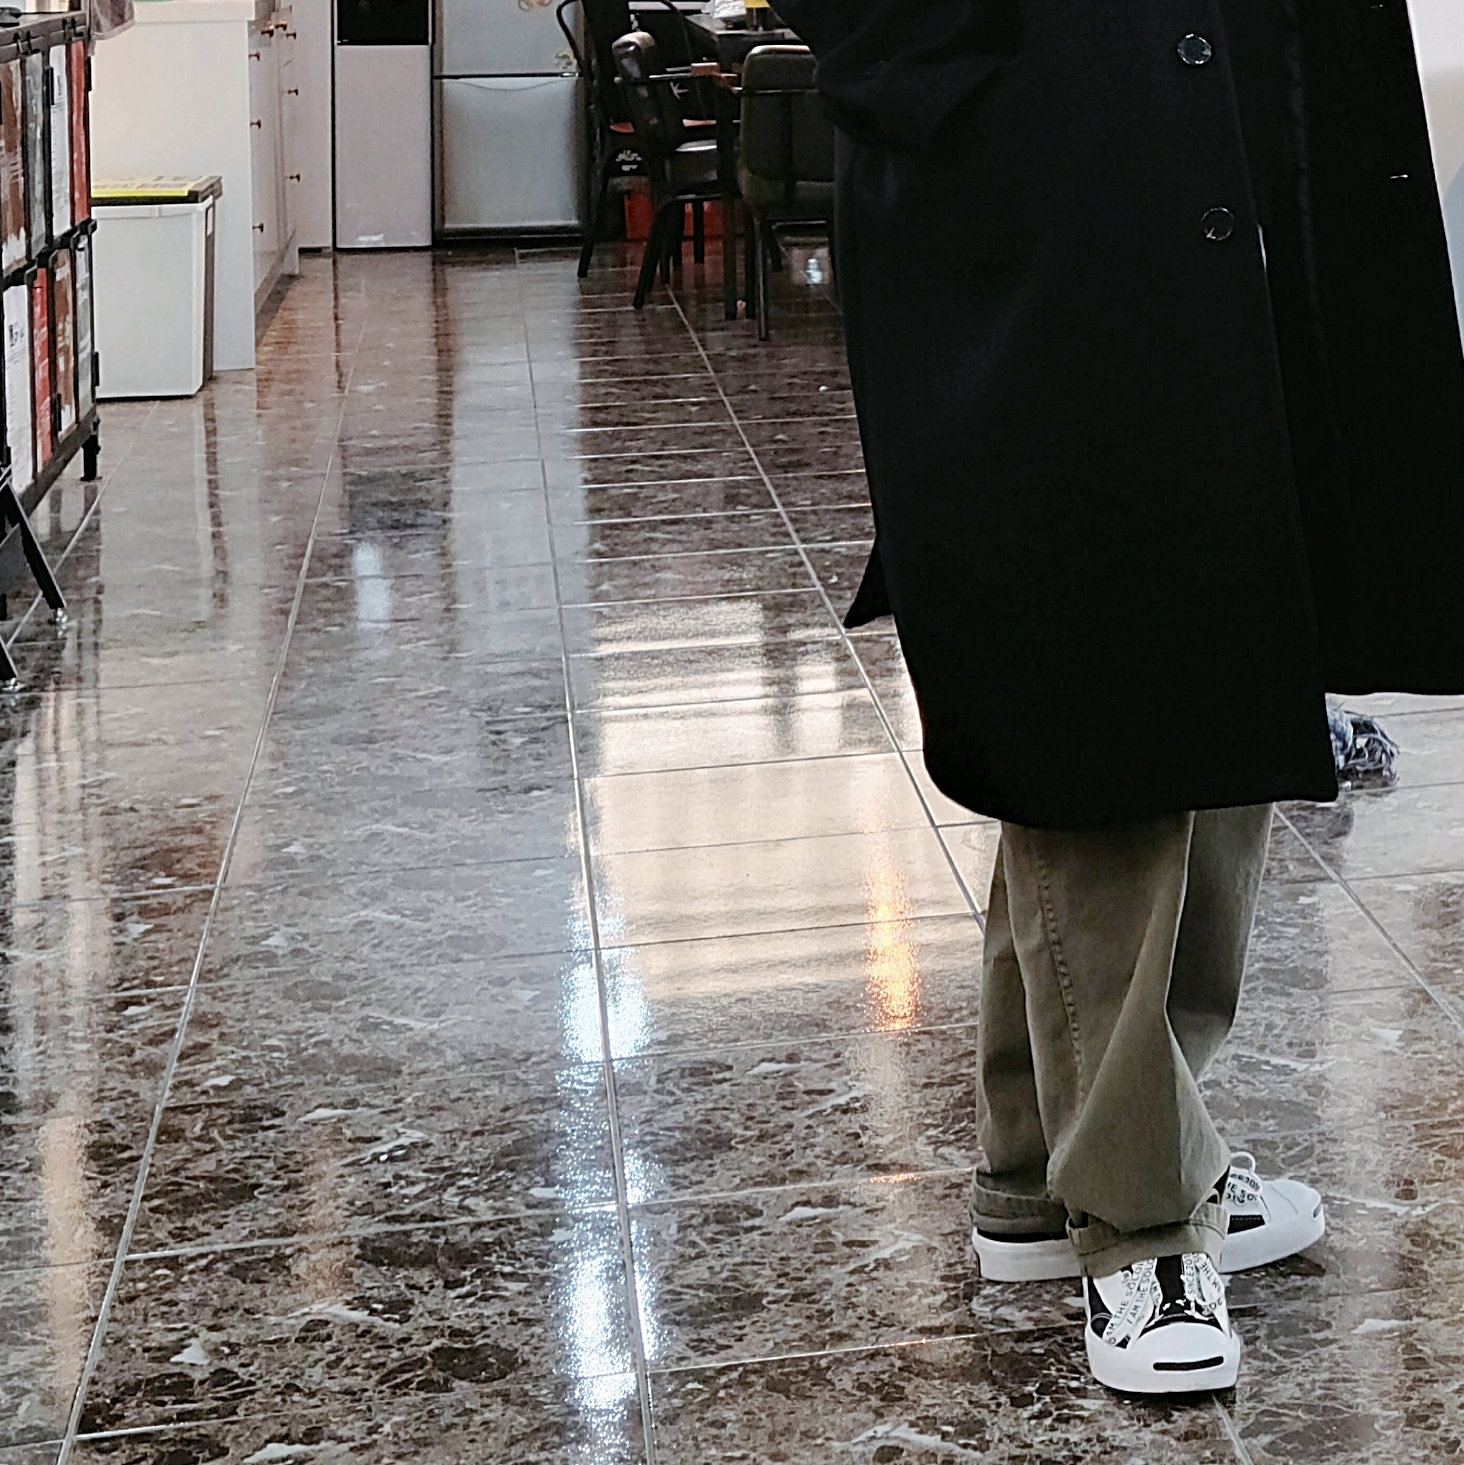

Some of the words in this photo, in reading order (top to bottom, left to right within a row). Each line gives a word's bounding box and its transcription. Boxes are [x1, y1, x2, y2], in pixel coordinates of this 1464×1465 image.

[1114, 1300, 1129, 1319] THE
[1130, 1305, 1141, 1318] AM
[1136, 1287, 1149, 1303] THE
